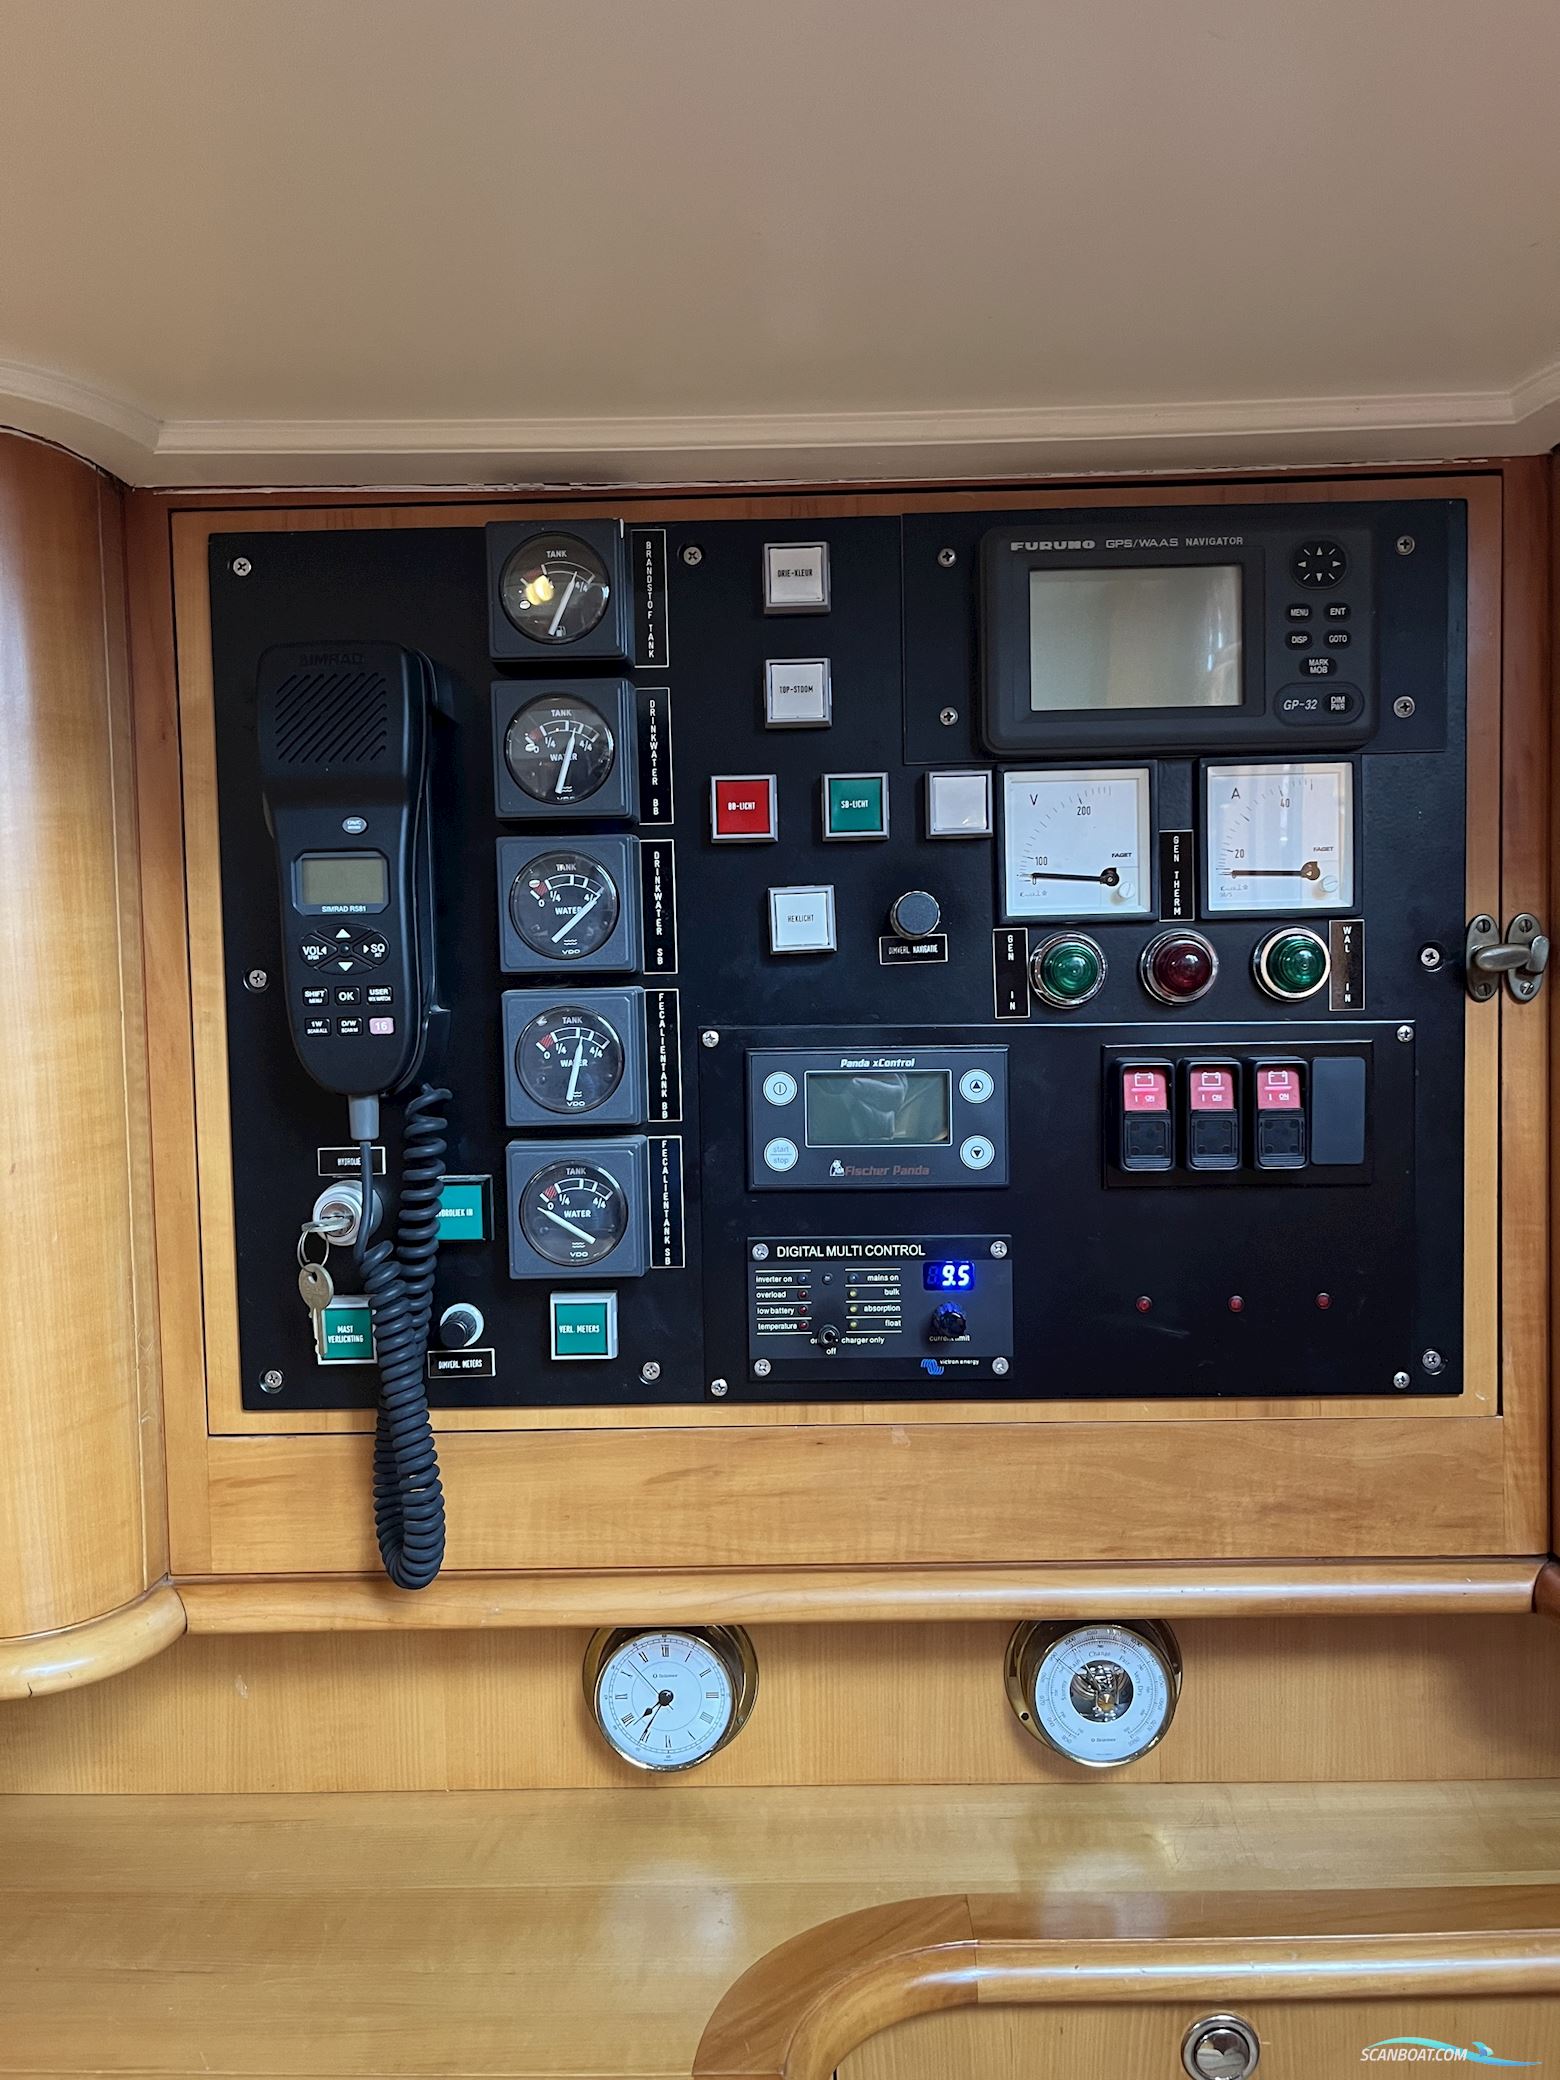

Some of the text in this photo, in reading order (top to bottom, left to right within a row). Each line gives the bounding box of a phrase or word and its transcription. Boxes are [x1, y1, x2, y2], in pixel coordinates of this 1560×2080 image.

[1010, 536, 1244, 551] FURUNO GPS/WAAS NAVIGATOR
[546, 550, 568, 559] TANK
[645, 540, 656, 659] BRANDSTOF TANK
[1290, 608, 1310, 617] MENU
[1329, 608, 1347, 617] ENT
[1291, 635, 1308, 644] DISP
[1328, 635, 1348, 643] GOTO
[1308, 658, 1330, 667] MARK
[1310, 666, 1328, 675] MOB
[1282, 699, 1319, 711] GP-32
[1330, 697, 1346, 705] DIM
[551, 709, 572, 718] TANK
[579, 740, 592, 751] 4/4
[649, 700, 661, 816] DRINKWATER BB
[1231, 787, 1241, 799] A
[840, 798, 868, 809] SB-LICHT
[1030, 794, 1039, 806] V
[1280, 799, 1290, 809] 40
[1077, 806, 1091, 816] 200
[1234, 849, 1245, 859] 20
[1035, 856, 1048, 866] 100
[555, 863, 577, 872] TANK
[1172, 836, 1182, 915] GEN THERM
[550, 891, 561, 902] 1/4
[538, 899, 545, 908] 0
[653, 850, 665, 965] DRINKWATER SB
[321, 905, 349, 913] SIMRAD
[302, 946, 323, 956] VOL
[370, 943, 385, 953] SQ
[1342, 926, 1353, 1003] WAL IN
[304, 990, 325, 998] SHIFT
[368, 988, 389, 996] USER
[338, 992, 355, 1002] OK
[1009, 990, 1016, 1011] IN
[562, 1016, 583, 1024] TANK
[375, 1022, 388, 1031] 16
[555, 1043, 567, 1054] 1/4
[589, 1046, 603, 1058] 4/4
[543, 1051, 550, 1060] 0
[658, 992, 669, 1119] FECALIENTANK BB
[839, 1057, 915, 1068] Panda xControl
[772, 1145, 789, 1153] start
[773, 1156, 789, 1165] stop
[565, 1168, 587, 1176] TANK
[844, 1165, 930, 1176] Fischer Panda
[559, 1193, 570, 1205] 1/4
[593, 1197, 606, 1209] 4/4
[661, 1139, 672, 1266] FECALIENTANK SB
[547, 1202, 555, 1211] 0
[563, 1209, 592, 1218] WATER
[776, 1244, 926, 1258] DIGITAL MULTI CONTROL
[755, 1275, 782, 1283] inverter
[867, 1274, 888, 1282] mains
[756, 1291, 786, 1299] overload
[770, 1307, 795, 1316] battery
[863, 1306, 901, 1314] absorption
[577, 1324, 600, 1333] METERS
[757, 1323, 798, 1332] temperature
[841, 1338, 885, 1346] charger only
